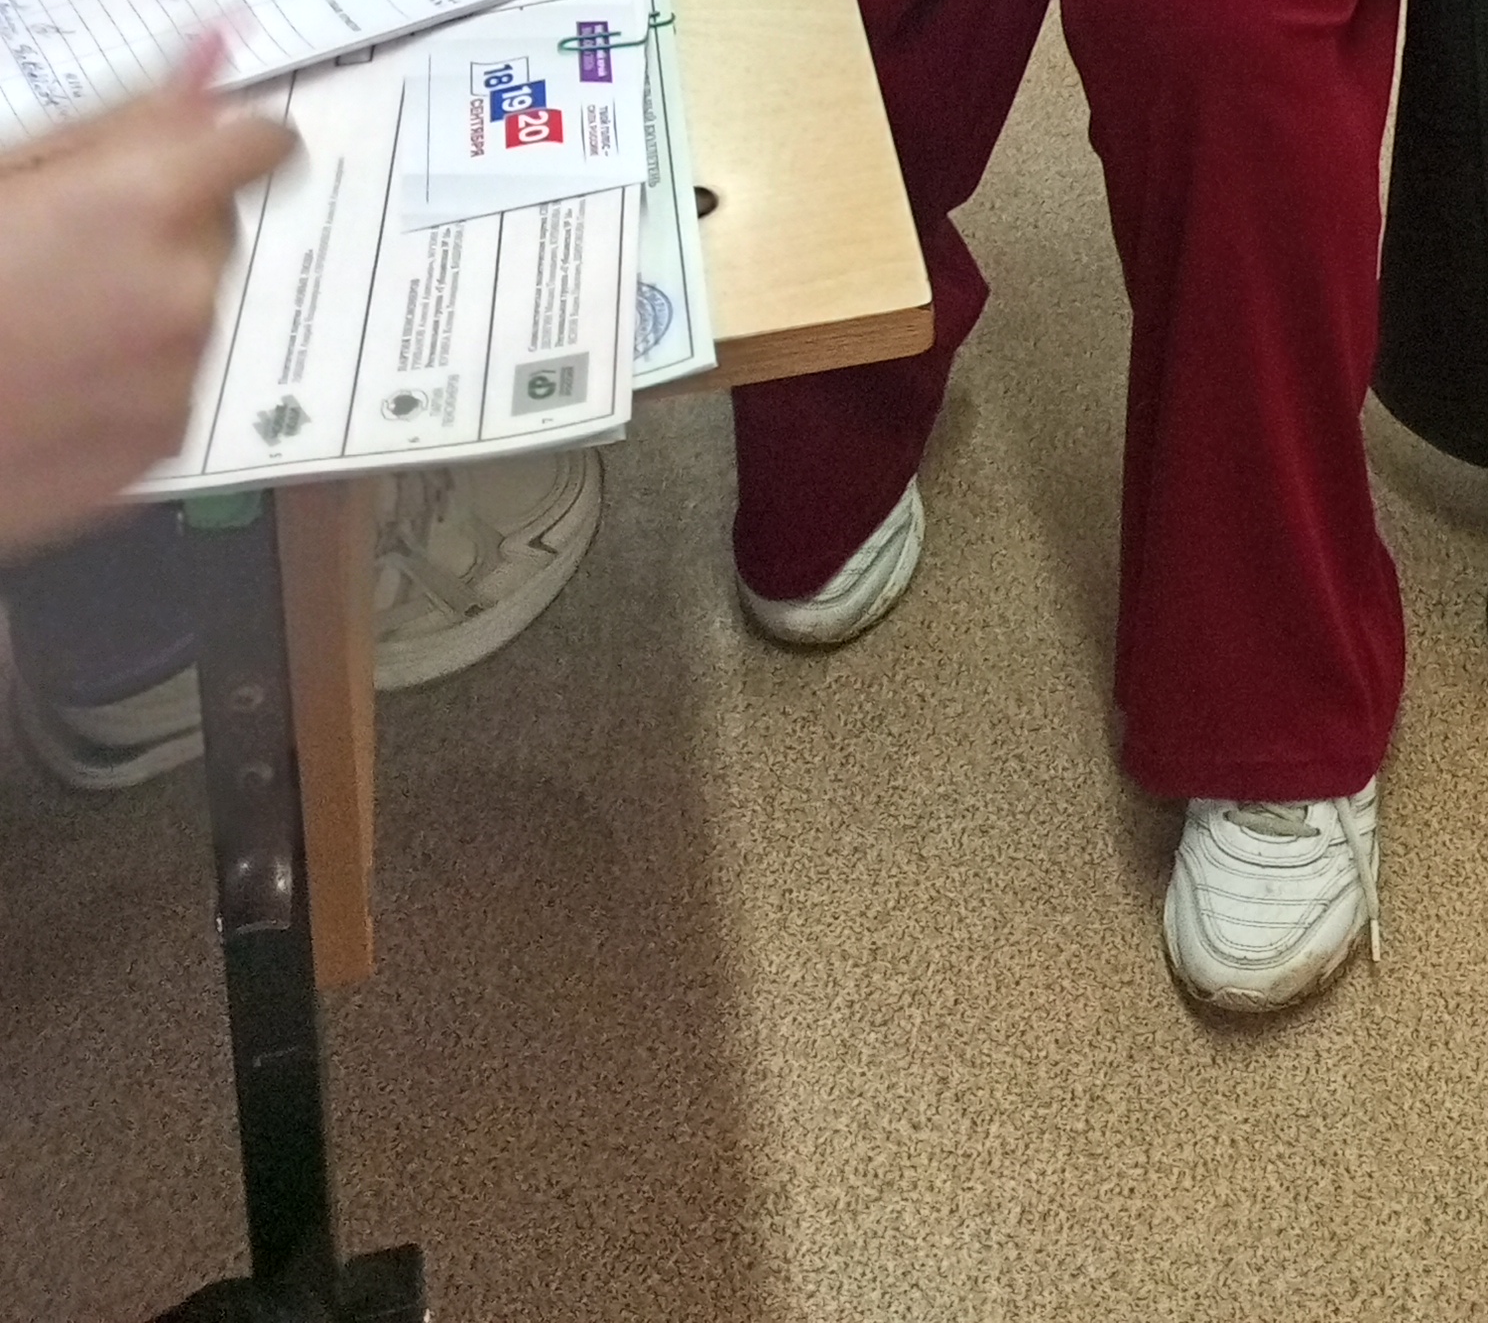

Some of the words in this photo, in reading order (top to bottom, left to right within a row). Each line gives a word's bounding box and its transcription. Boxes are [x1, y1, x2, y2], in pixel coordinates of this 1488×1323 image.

[470, 98, 485, 157] СЕНТЯБРЯ
[484, 64, 514, 89] 18
[502, 85, 532, 112] 19
[518, 111, 549, 142] 20
